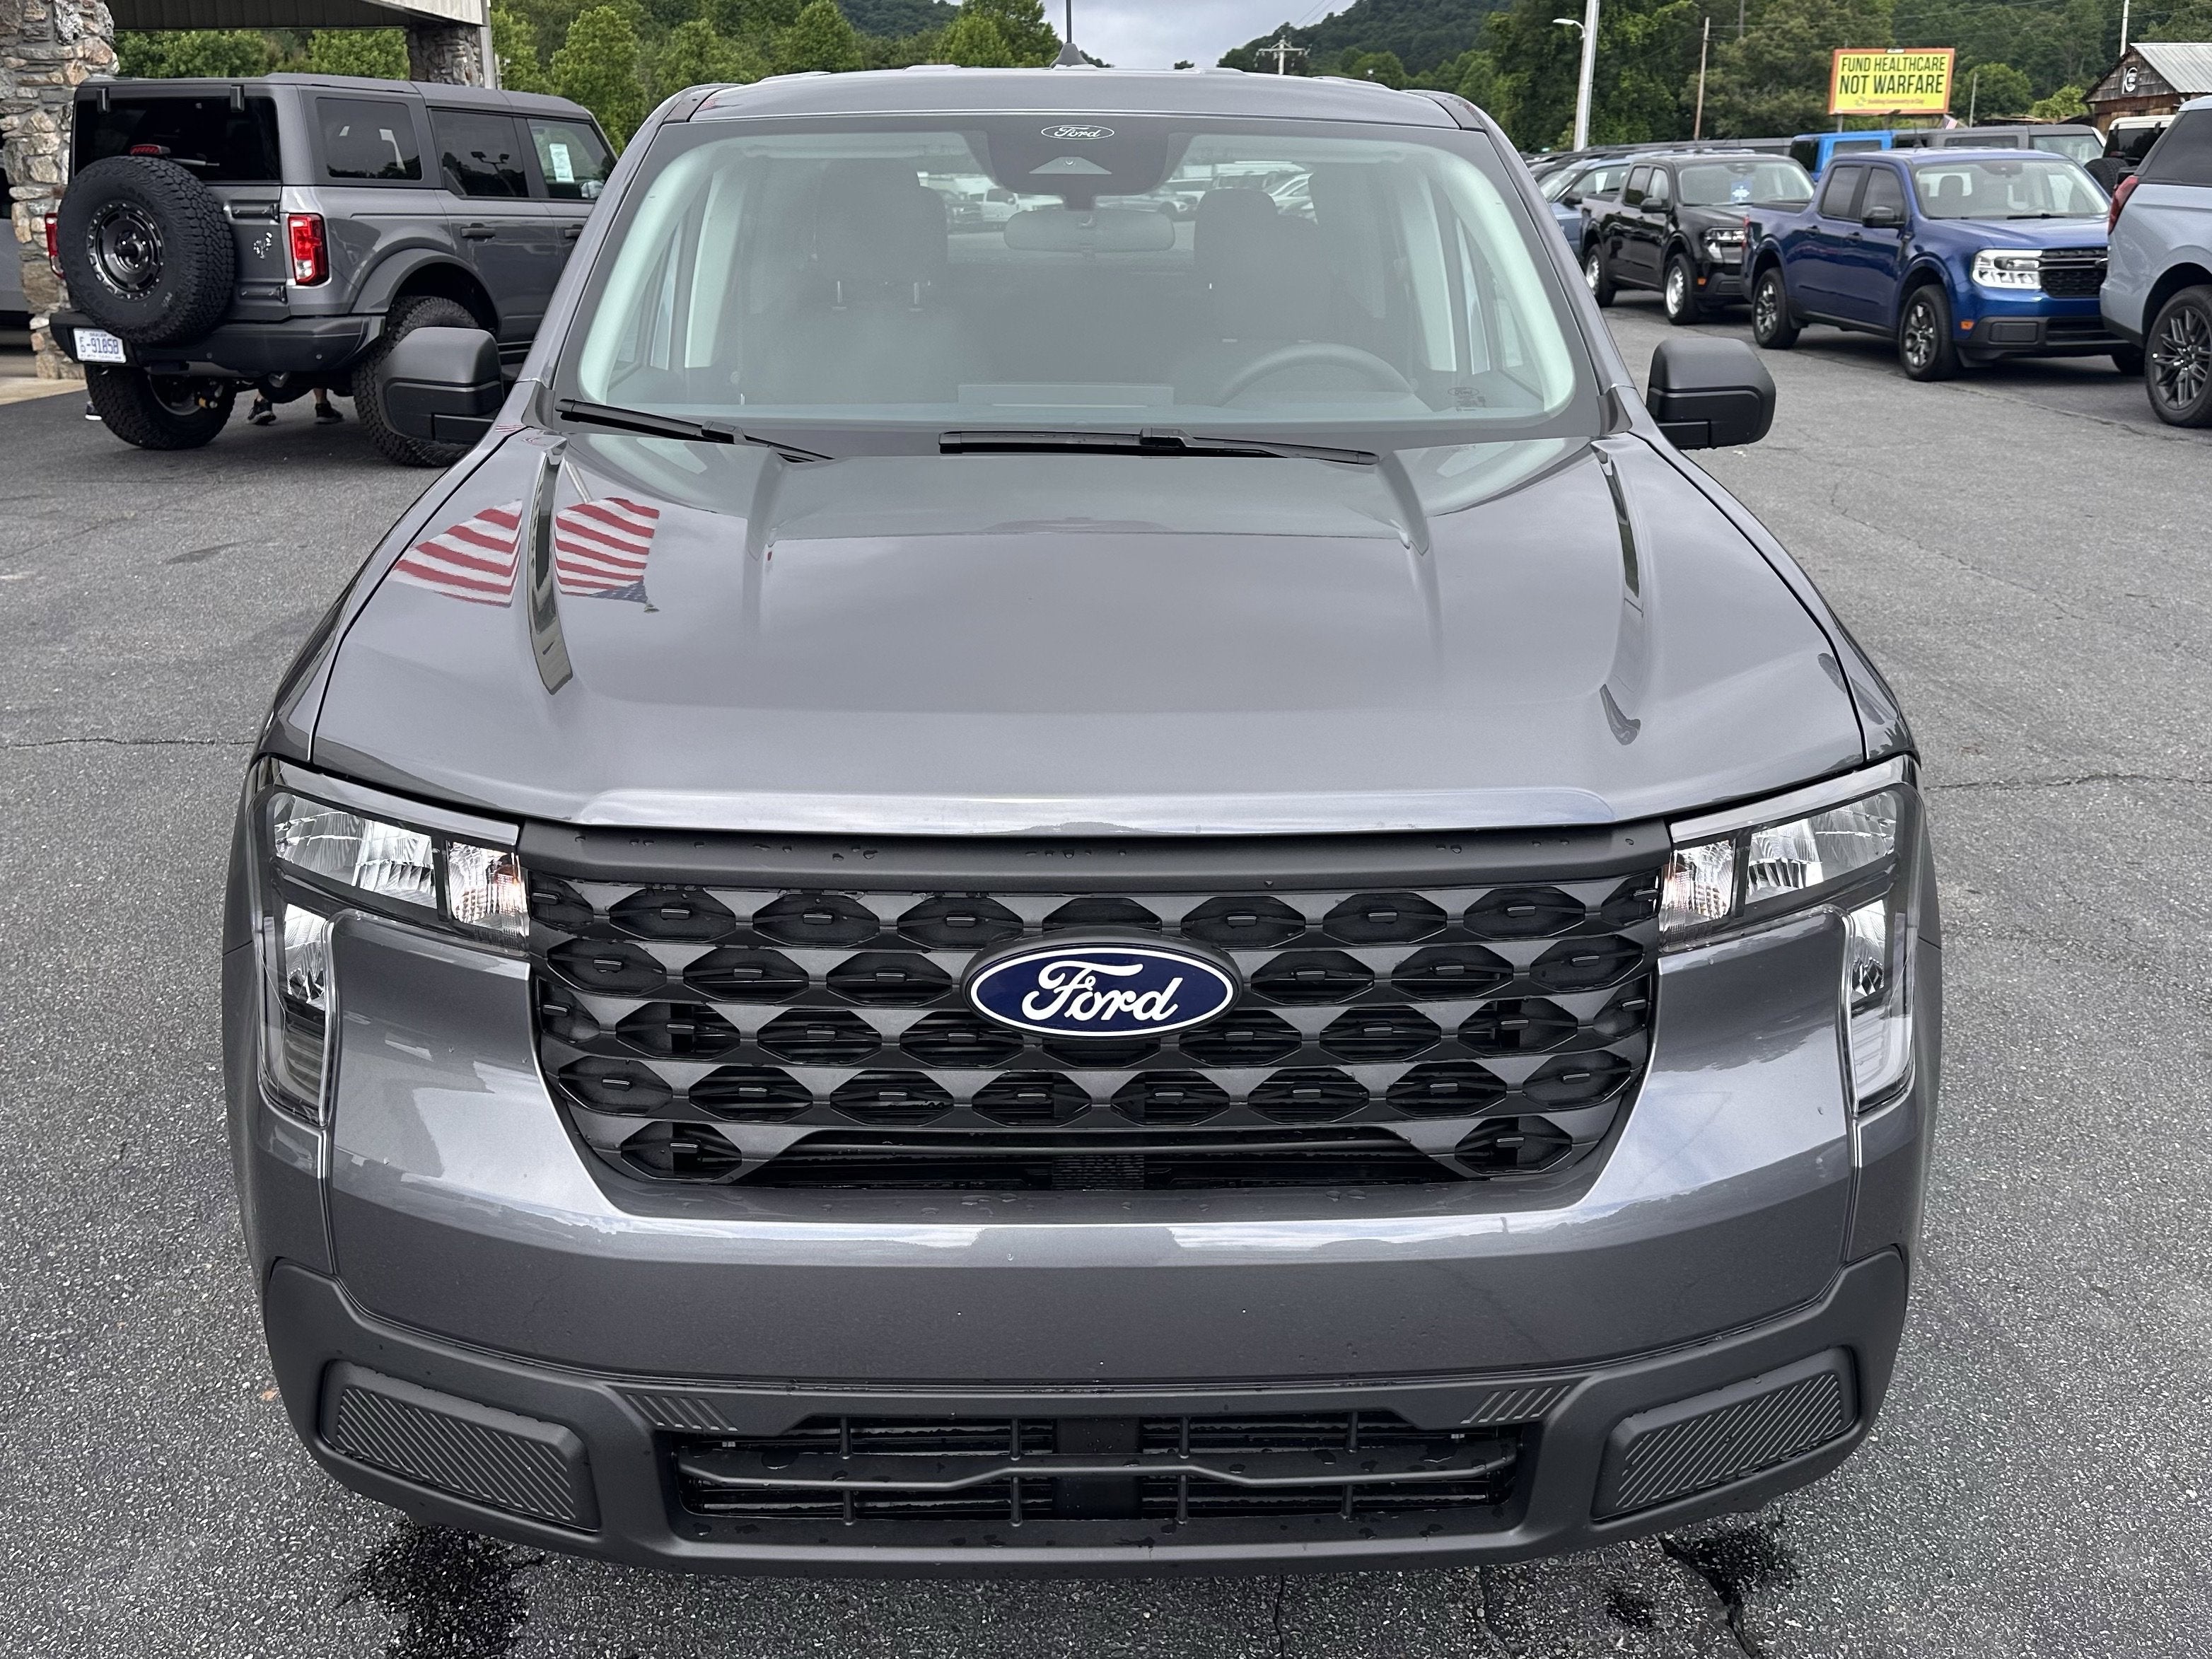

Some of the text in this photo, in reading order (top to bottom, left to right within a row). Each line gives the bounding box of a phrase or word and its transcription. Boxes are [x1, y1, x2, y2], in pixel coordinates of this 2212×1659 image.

[1841, 56, 1946, 72] FUND HEALTHCARE
[1839, 74, 1945, 94] NOT WARFARE
[1054, 127, 1102, 138] Ford
[1022, 960, 1183, 1021] Ford
